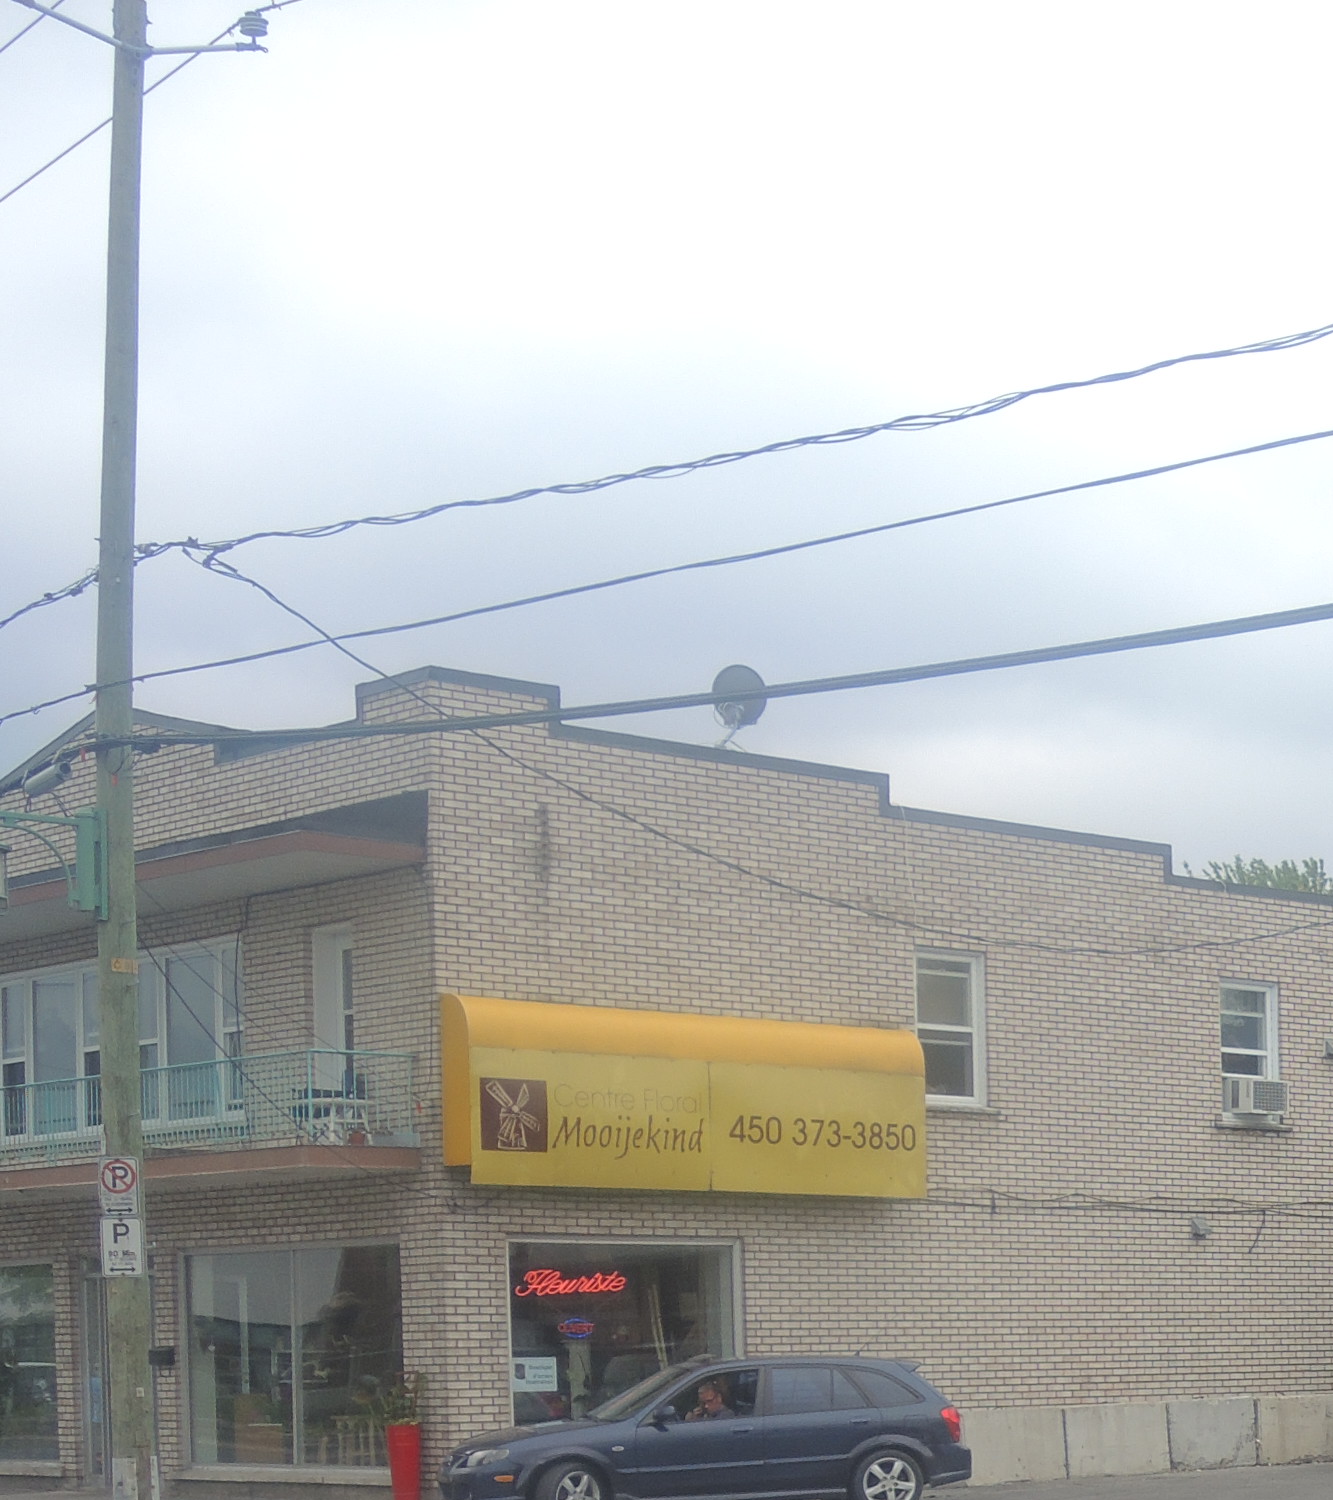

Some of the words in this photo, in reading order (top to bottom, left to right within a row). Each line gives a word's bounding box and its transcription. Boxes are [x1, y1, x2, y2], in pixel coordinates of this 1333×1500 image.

[552, 1083, 636, 1110] Centre
[643, 1086, 702, 1115] Floral
[552, 1115, 705, 1160] Mooijekind
[728, 1115, 782, 1145] 450
[791, 1118, 917, 1152] 373-3850
[112, 1223, 129, 1244] P
[515, 1268, 628, 1297] Fleuriste
